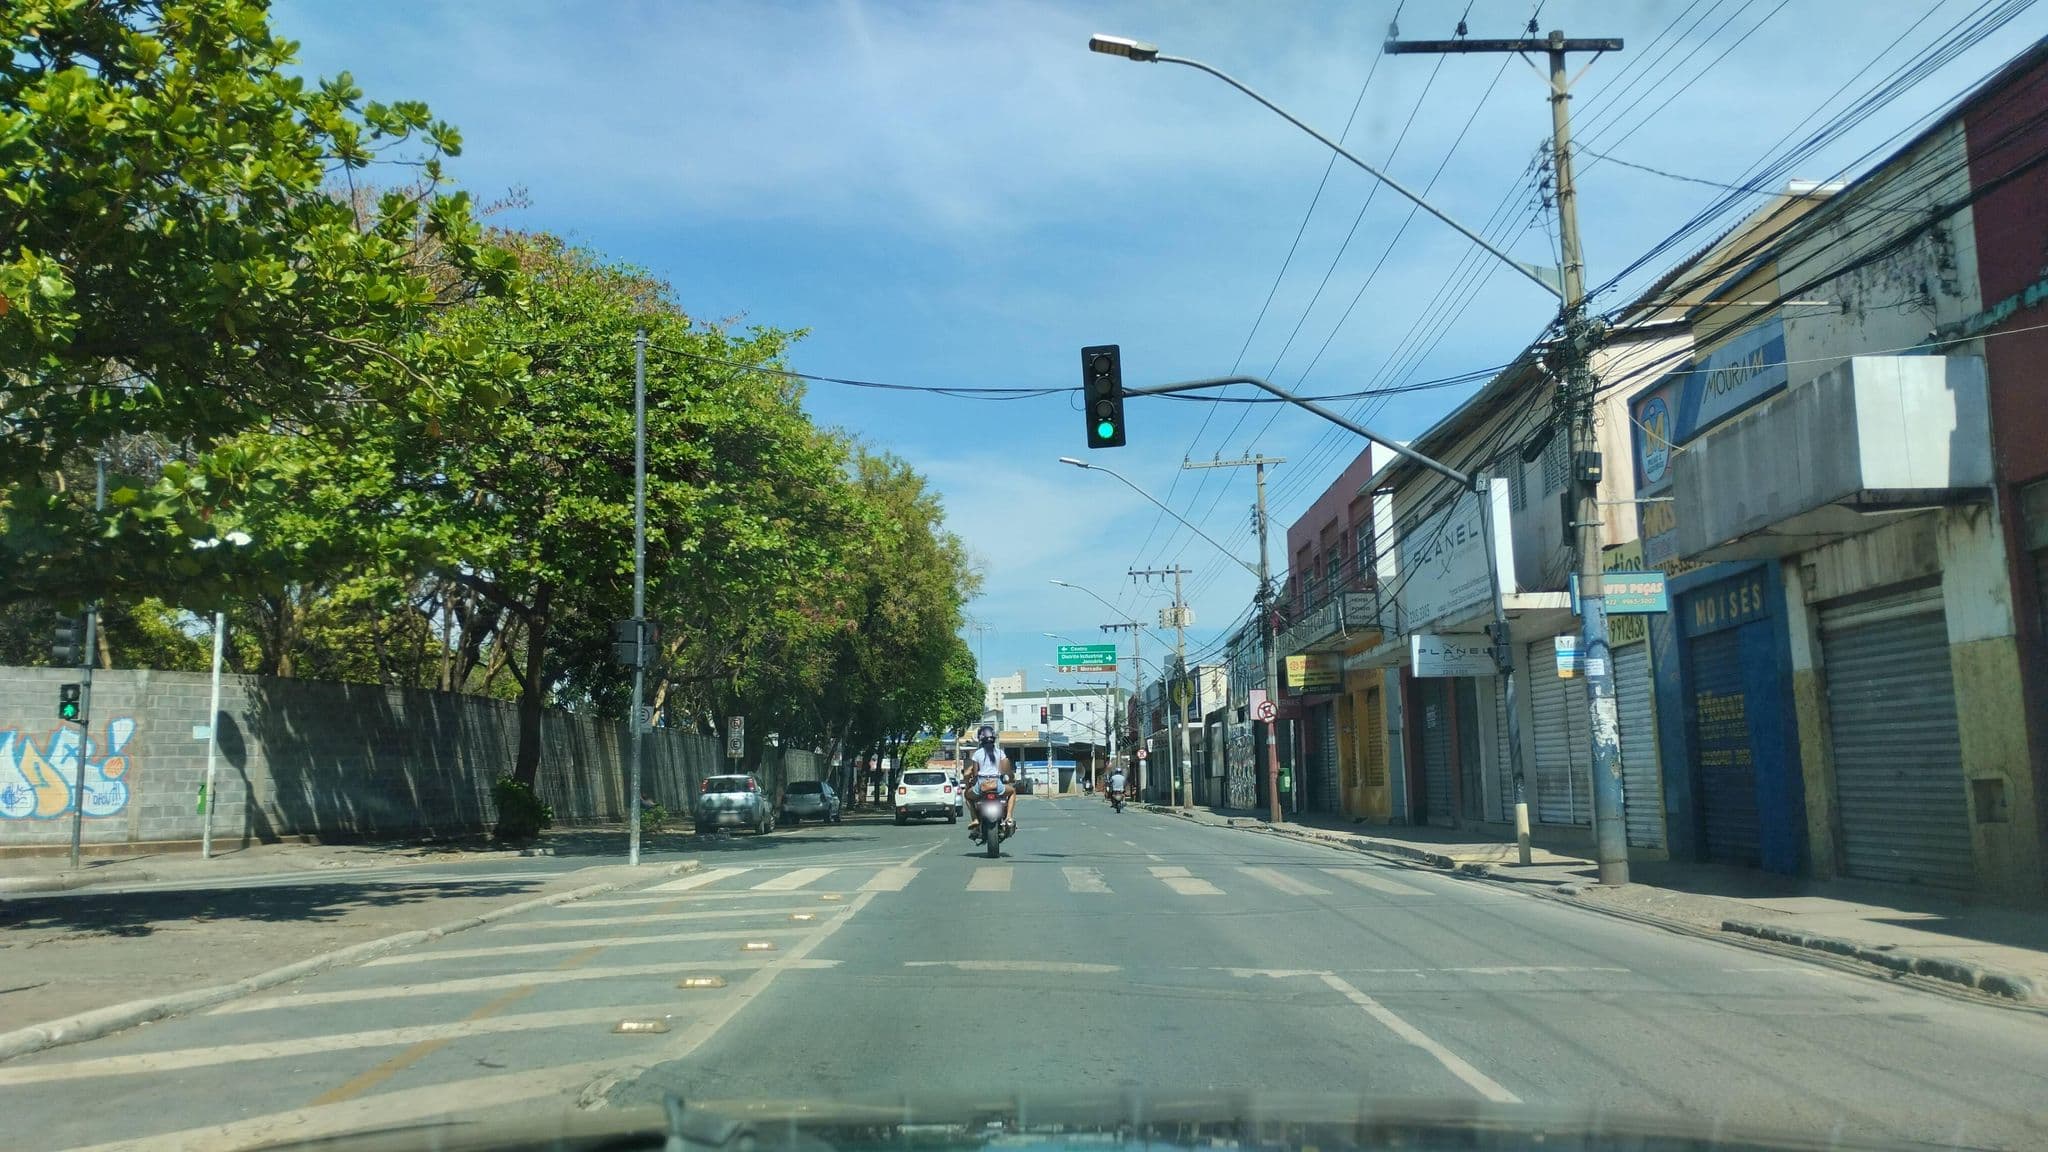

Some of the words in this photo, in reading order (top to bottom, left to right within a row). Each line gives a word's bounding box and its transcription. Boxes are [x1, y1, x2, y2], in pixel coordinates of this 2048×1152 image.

[1704, 357, 1748, 404] MOURA
[1413, 521, 1478, 566] PLANEL
[1629, 582, 1664, 596] PEÇAS
